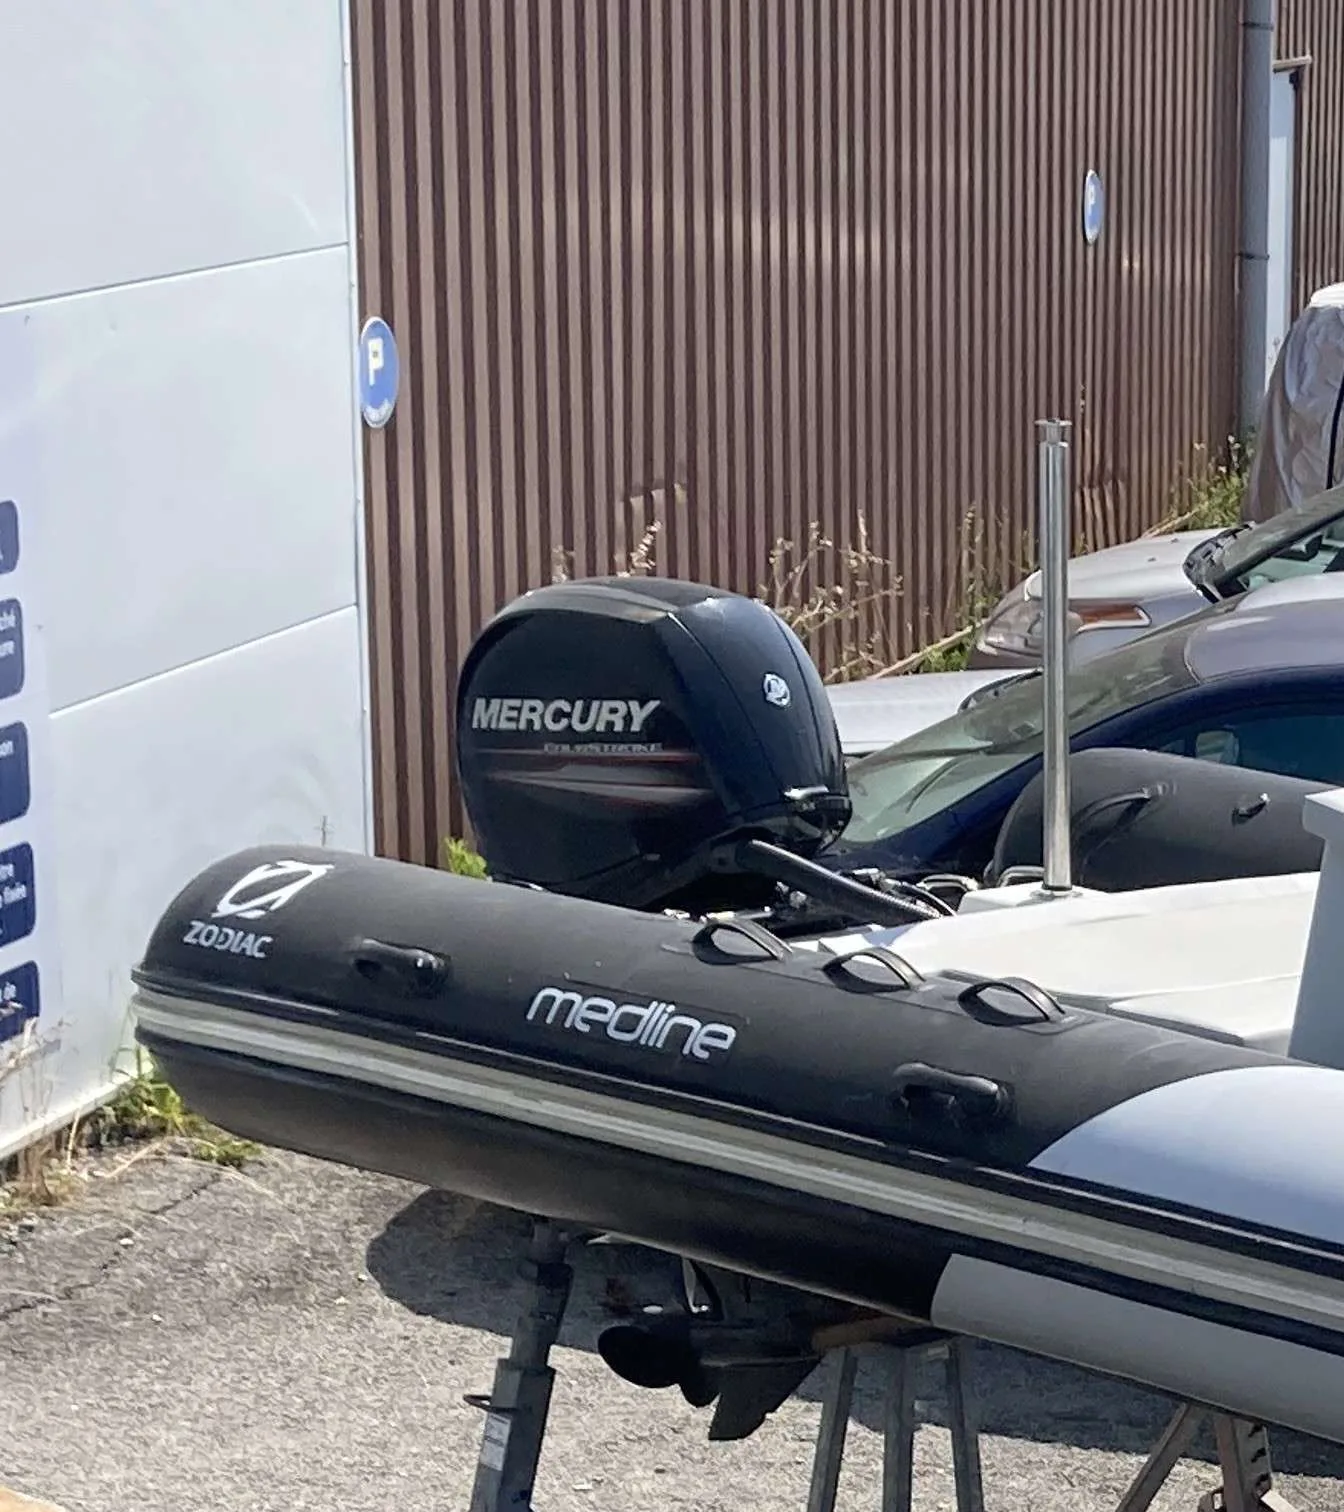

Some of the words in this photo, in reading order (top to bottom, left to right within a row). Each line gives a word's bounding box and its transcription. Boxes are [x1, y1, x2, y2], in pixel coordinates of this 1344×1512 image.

[367, 337, 384, 386] P
[472, 697, 661, 733] MERCURY
[183, 920, 274, 959] ZODIAC
[525, 987, 737, 1060] medline
